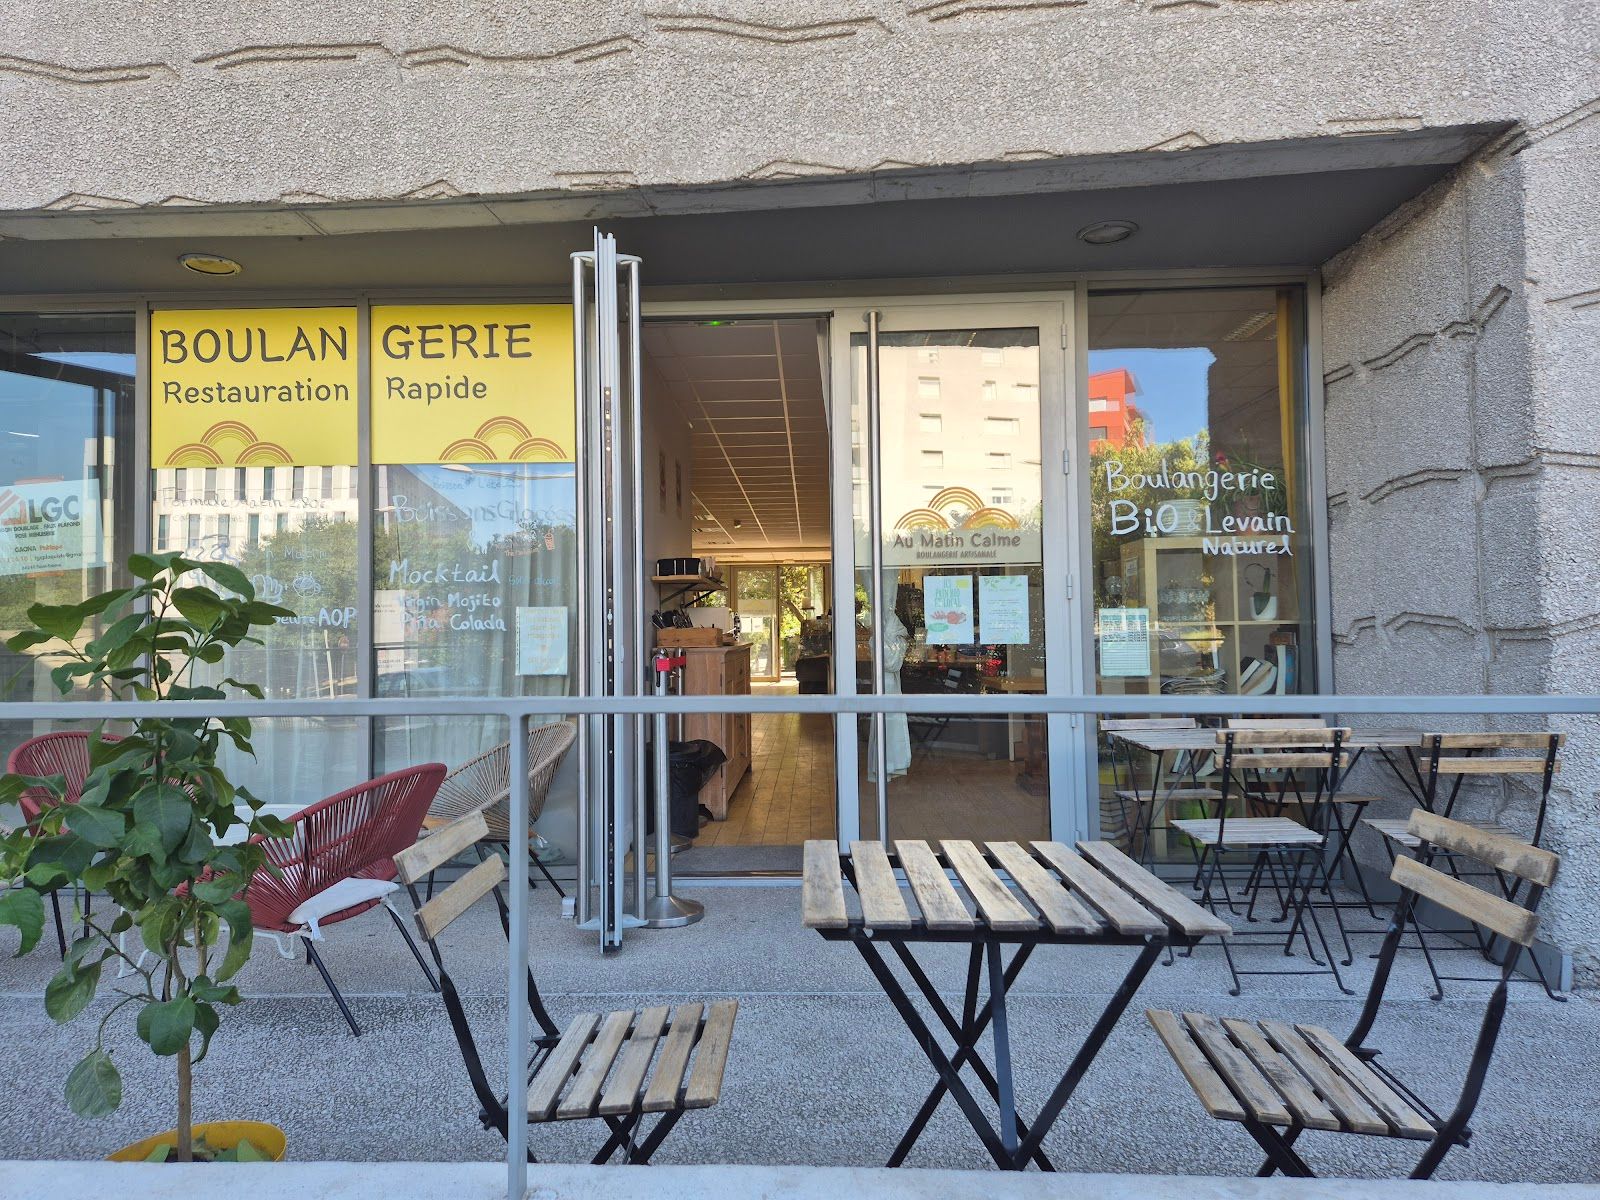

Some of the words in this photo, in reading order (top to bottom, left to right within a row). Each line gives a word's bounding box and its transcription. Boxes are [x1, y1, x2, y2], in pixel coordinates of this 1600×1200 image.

[160, 325, 348, 365] BOULAN
[382, 323, 533, 361] GERIE
[163, 377, 350, 404] Restauration
[386, 375, 488, 407] Rapide
[1103, 458, 1275, 501] Boulangerie
[28, 495, 80, 523] LGC
[1204, 505, 1296, 535] Levain
[892, 533, 914, 551] Au
[920, 532, 965, 548] Matin
[971, 532, 1021, 548] Calme
[916, 550, 958, 559] BOULANGERIE
[960, 550, 997, 559] ARTISANALE
[1203, 534, 1294, 557] Naturel
[389, 558, 501, 585] Mocktail
[447, 592, 502, 612] Mojito
[318, 607, 357, 629] AOP
[450, 613, 507, 632] Colada
